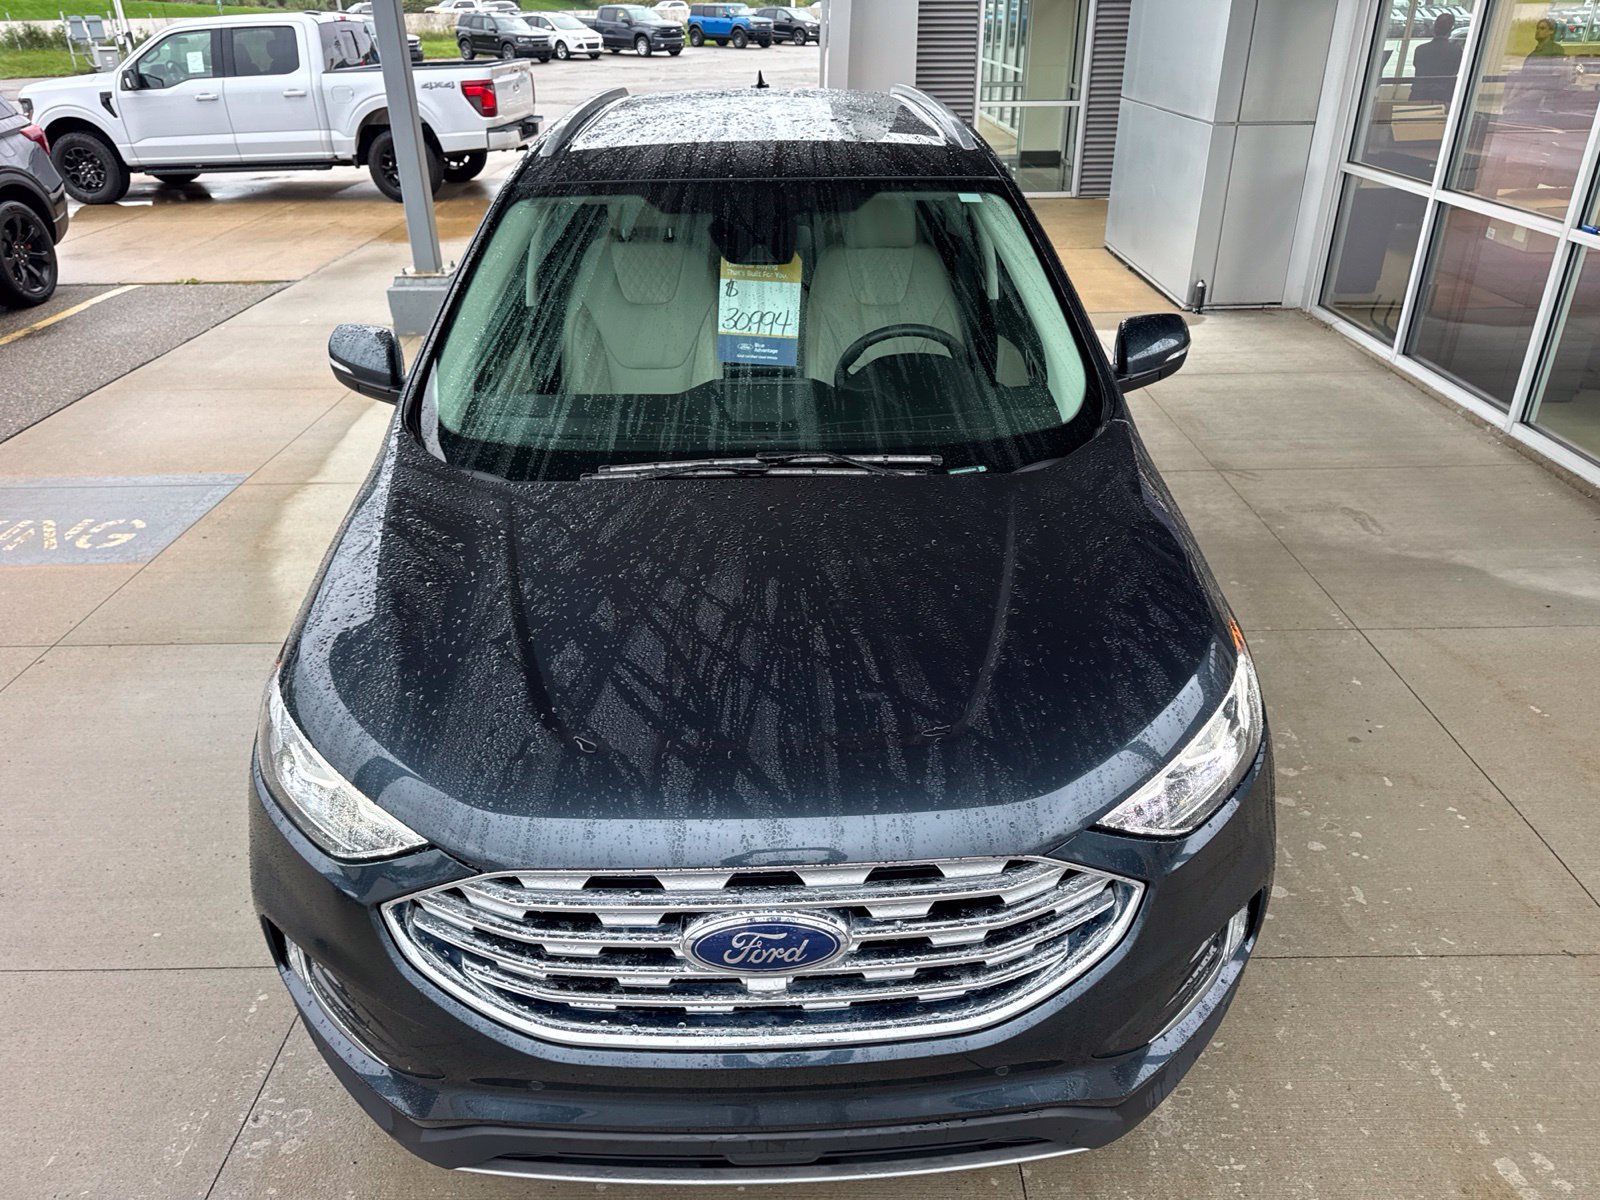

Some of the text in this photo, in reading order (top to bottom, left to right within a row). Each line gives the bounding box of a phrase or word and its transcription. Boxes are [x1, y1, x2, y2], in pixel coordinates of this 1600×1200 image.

[725, 278, 738, 297] $
[722, 308, 792, 336] 30,994
[723, 932, 808, 964] Ford
